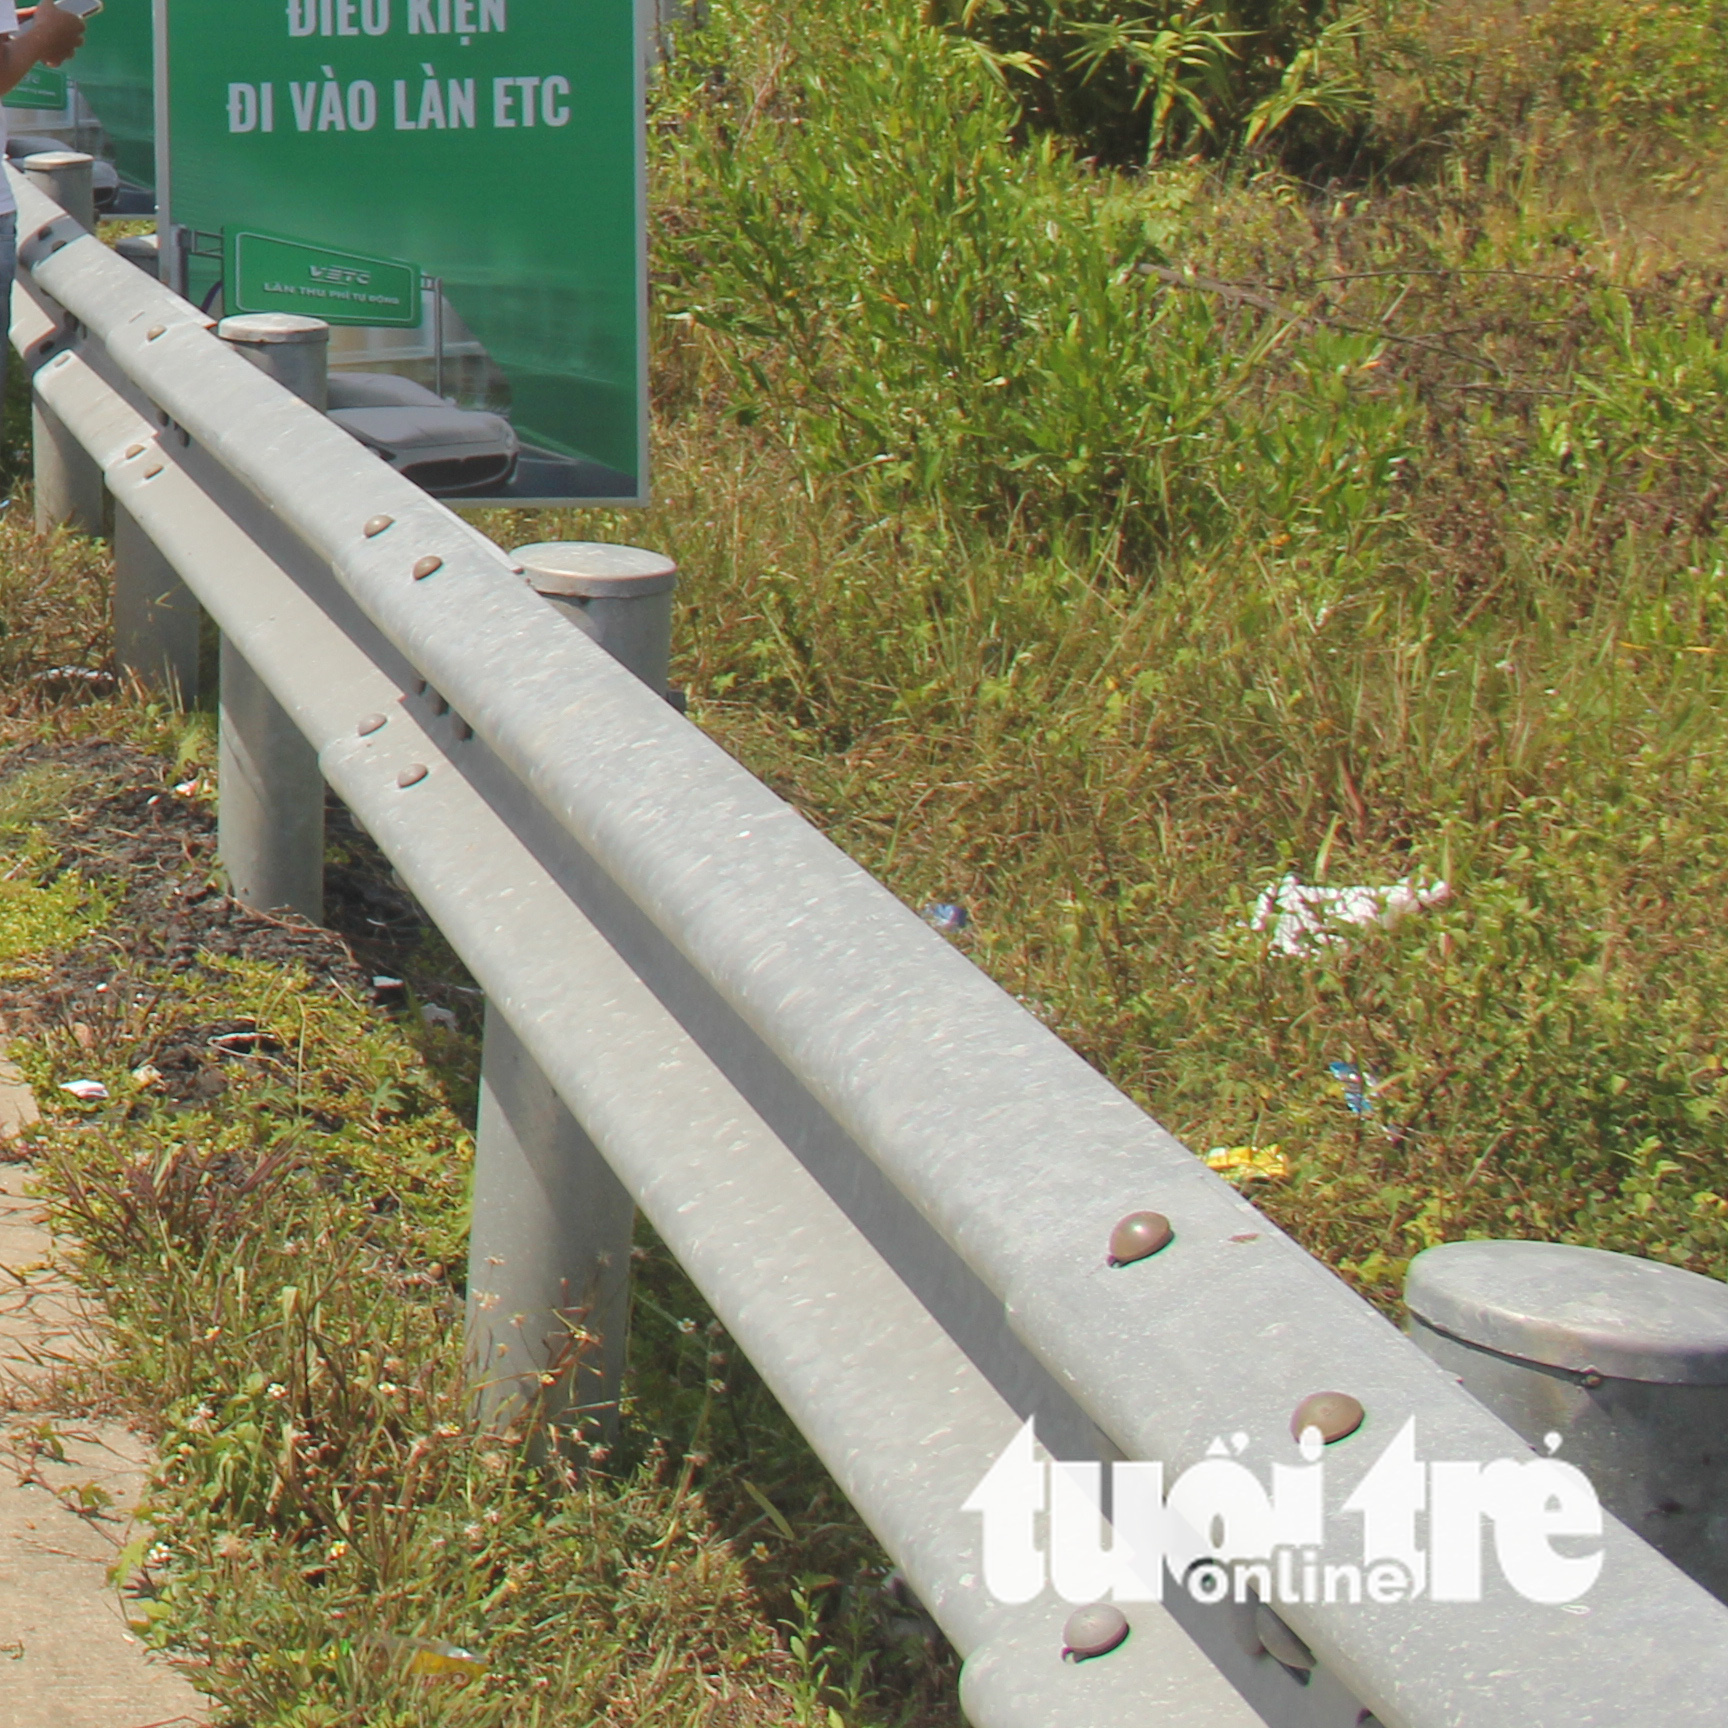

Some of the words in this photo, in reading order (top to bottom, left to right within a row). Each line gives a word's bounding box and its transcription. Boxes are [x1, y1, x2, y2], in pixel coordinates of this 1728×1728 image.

[227, 81, 274, 133] ĐI
[290, 65, 377, 132] VÀO
[393, 64, 476, 130] LÀN
[492, 75, 571, 128] ETC
[299, 286, 327, 298] THU
